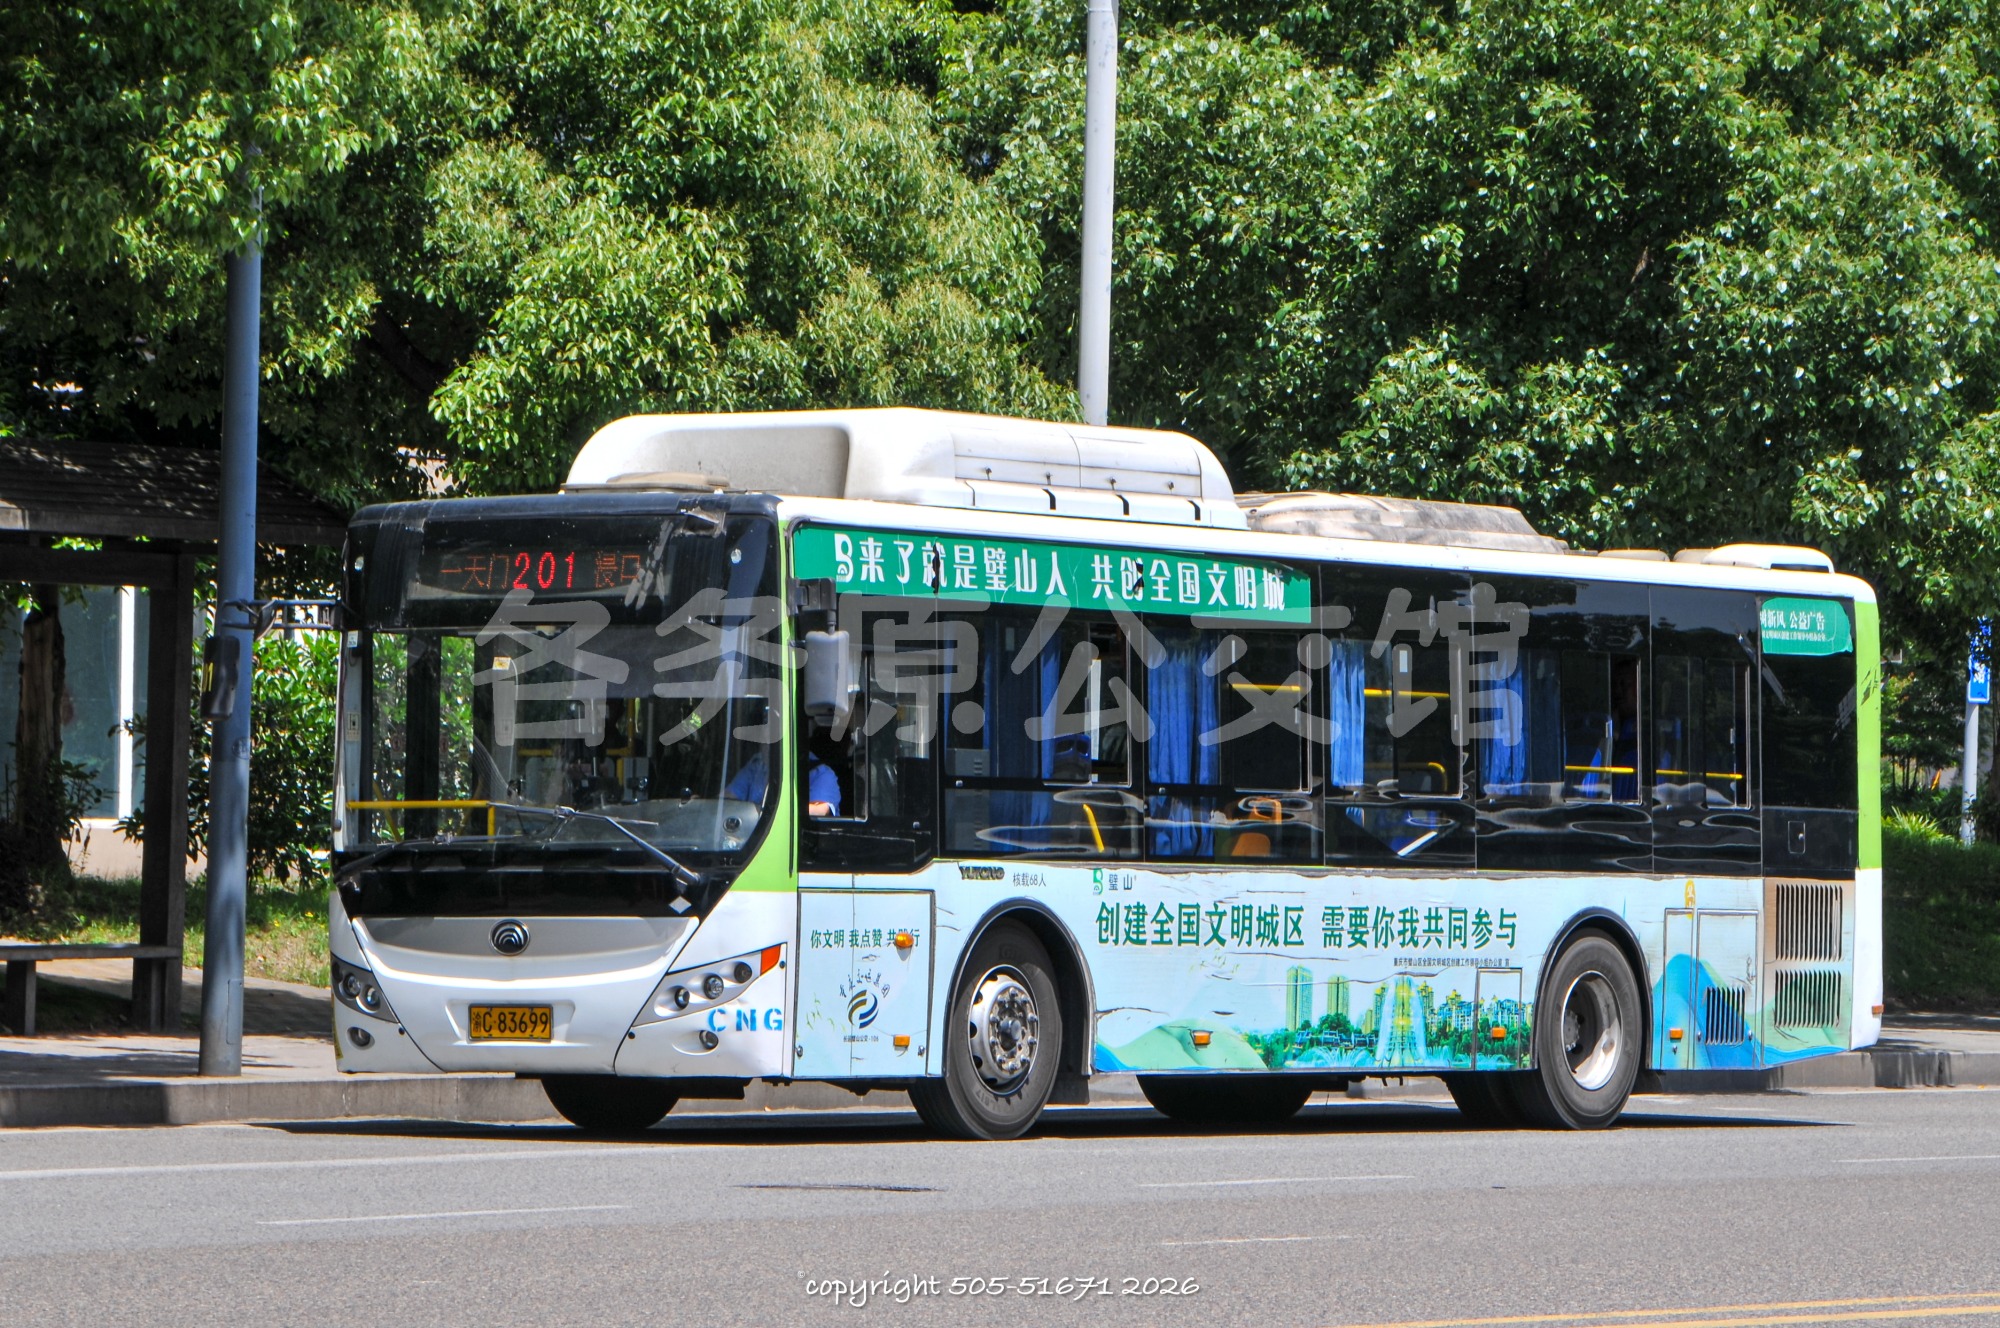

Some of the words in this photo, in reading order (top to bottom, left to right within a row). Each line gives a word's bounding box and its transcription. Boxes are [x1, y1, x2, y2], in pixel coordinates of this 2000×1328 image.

[440, 553, 509, 590] 一天门
[513, 552, 574, 589] 201
[859, 536, 1068, 598] 来了就是璧山人
[1091, 554, 1286, 612] 共创全国文明城
[1789, 610, 1825, 632] 公益广告
[1013, 872, 1046, 887] 核载68人
[1109, 874, 1132, 890] 璧山
[1096, 901, 1305, 948] 创建全国文明城区
[1321, 905, 1517, 950] 需要你我共同参与
[810, 929, 844, 949] 你文明
[849, 928, 882, 948] 我点赞
[887, 928, 920, 948] 共行
[708, 1008, 782, 1032] CNG
